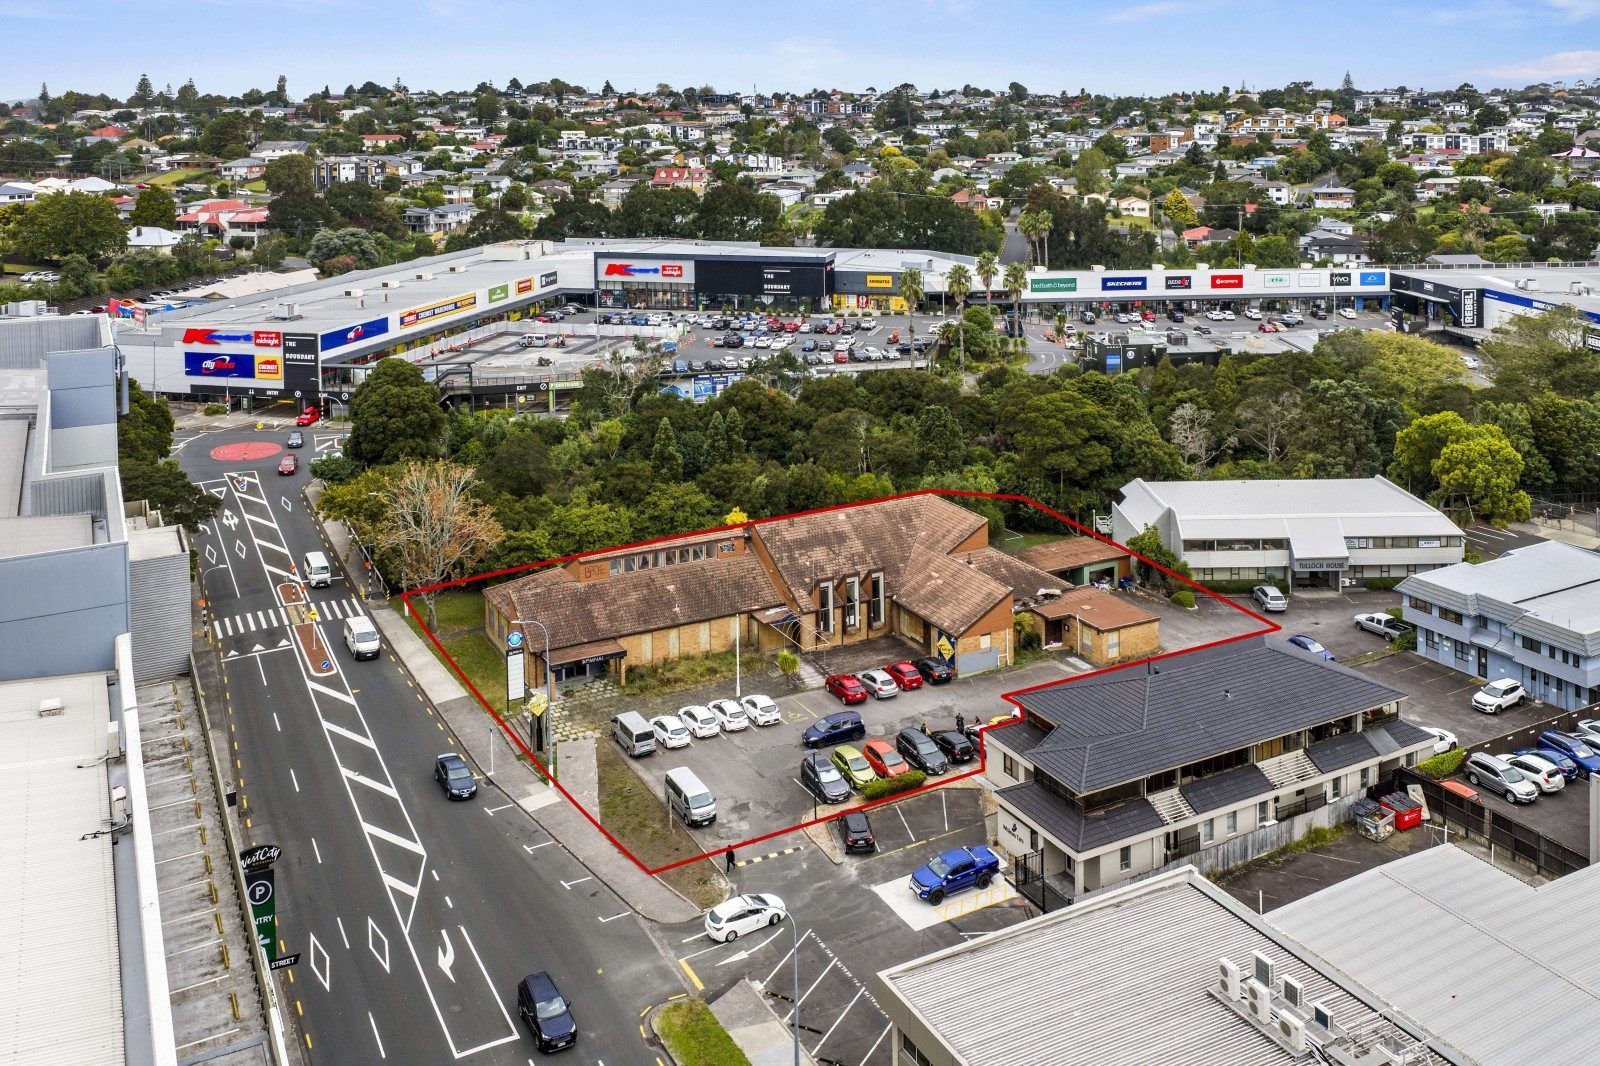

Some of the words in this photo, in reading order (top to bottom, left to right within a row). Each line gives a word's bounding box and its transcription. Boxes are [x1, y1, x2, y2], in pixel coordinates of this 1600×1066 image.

[1464, 292, 1474, 324] REBEL
[255, 338, 279, 346] midnight
[285, 352, 315, 361] BOUNDARY
[255, 886, 265, 900] P
[254, 914, 273, 925] NTRY
[270, 956, 296, 969] STREET
[836, 960, 853, 978] HEALTH
